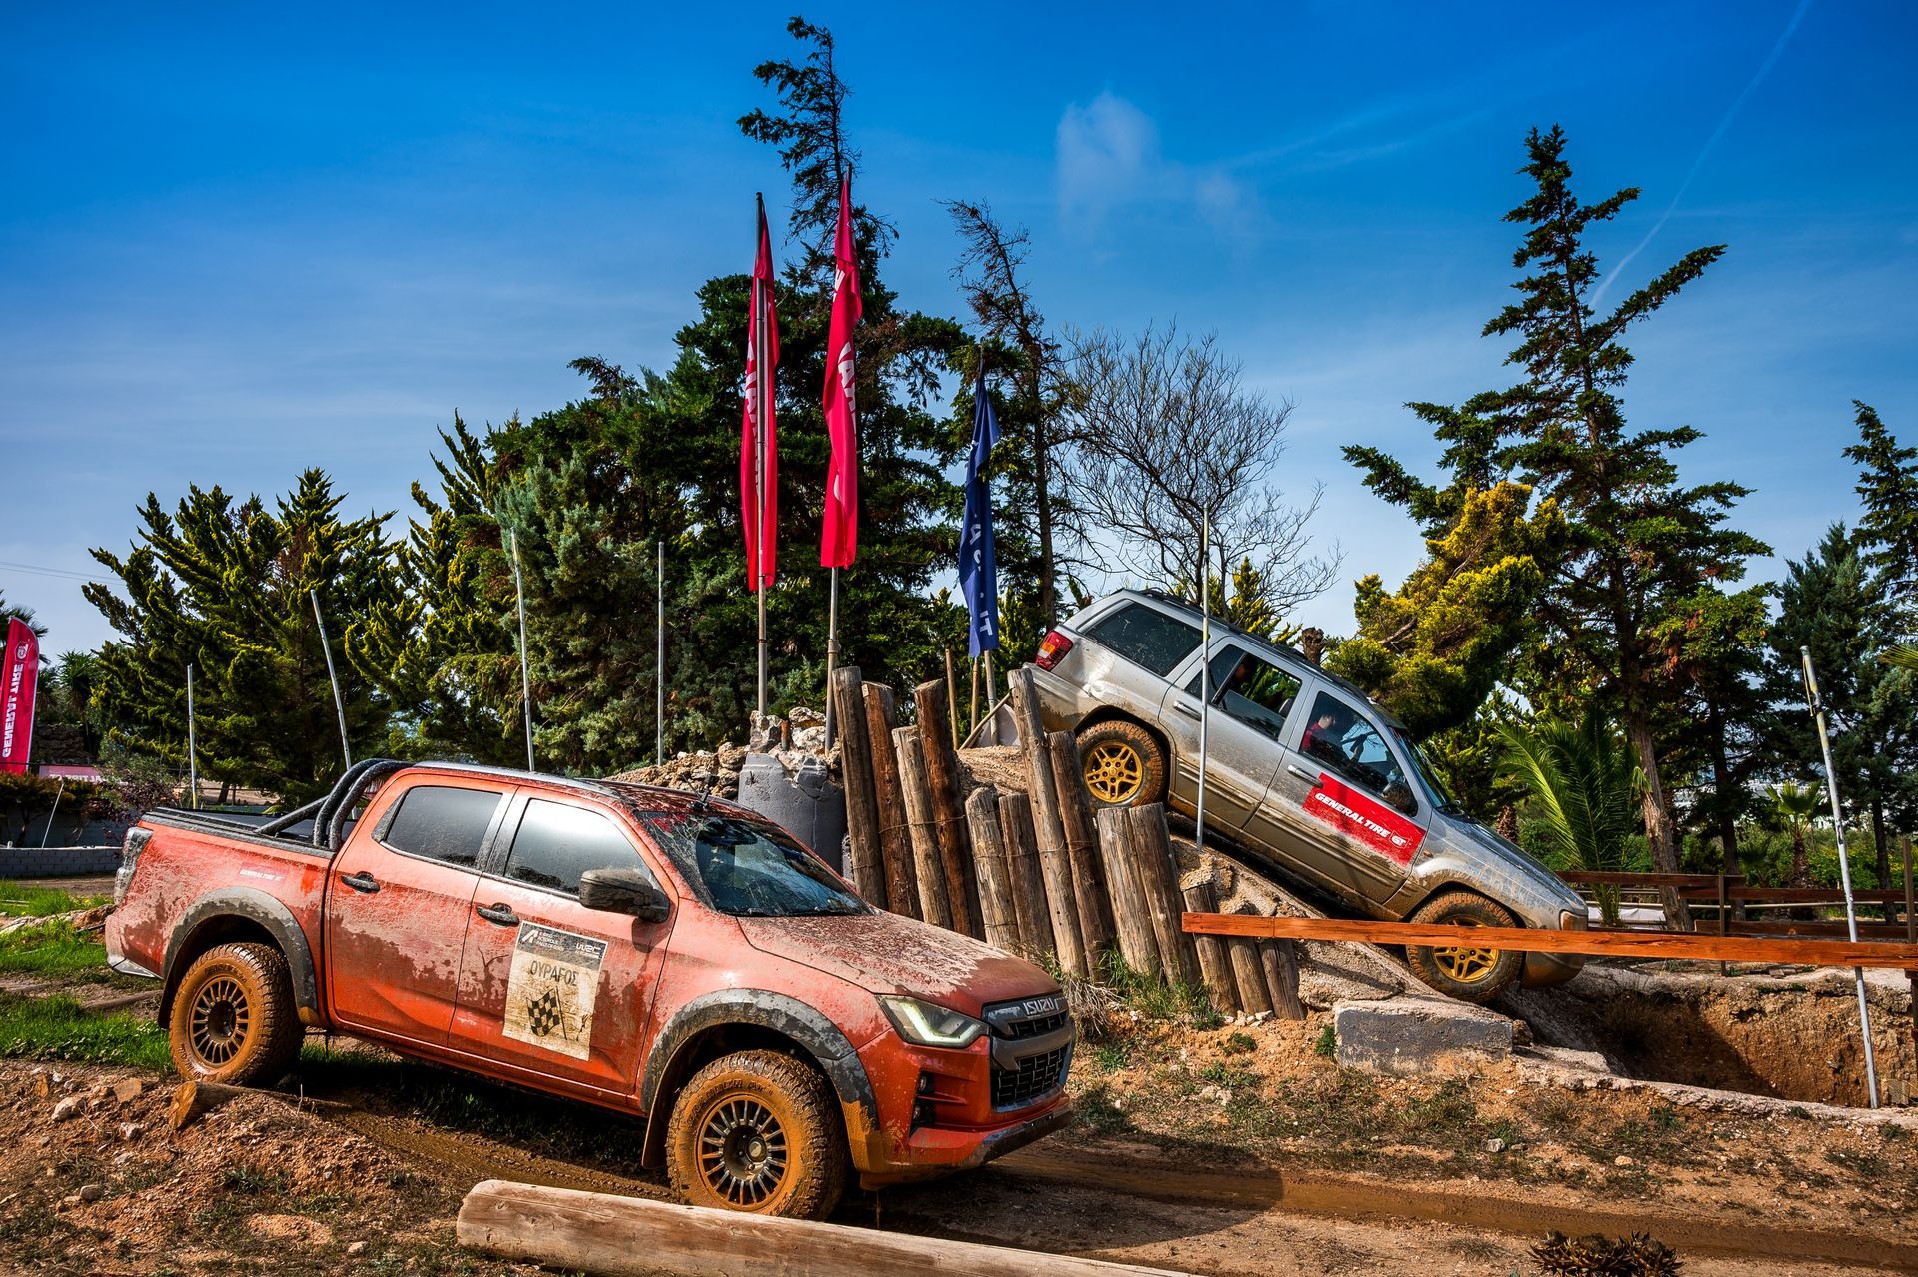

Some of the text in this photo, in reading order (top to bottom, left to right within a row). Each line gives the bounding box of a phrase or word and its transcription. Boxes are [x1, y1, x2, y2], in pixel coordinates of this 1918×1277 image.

[1315, 792, 1364, 825] GENERAL
[1363, 820, 1391, 838] TIRE
[1023, 997, 1055, 1015] ISUZU
